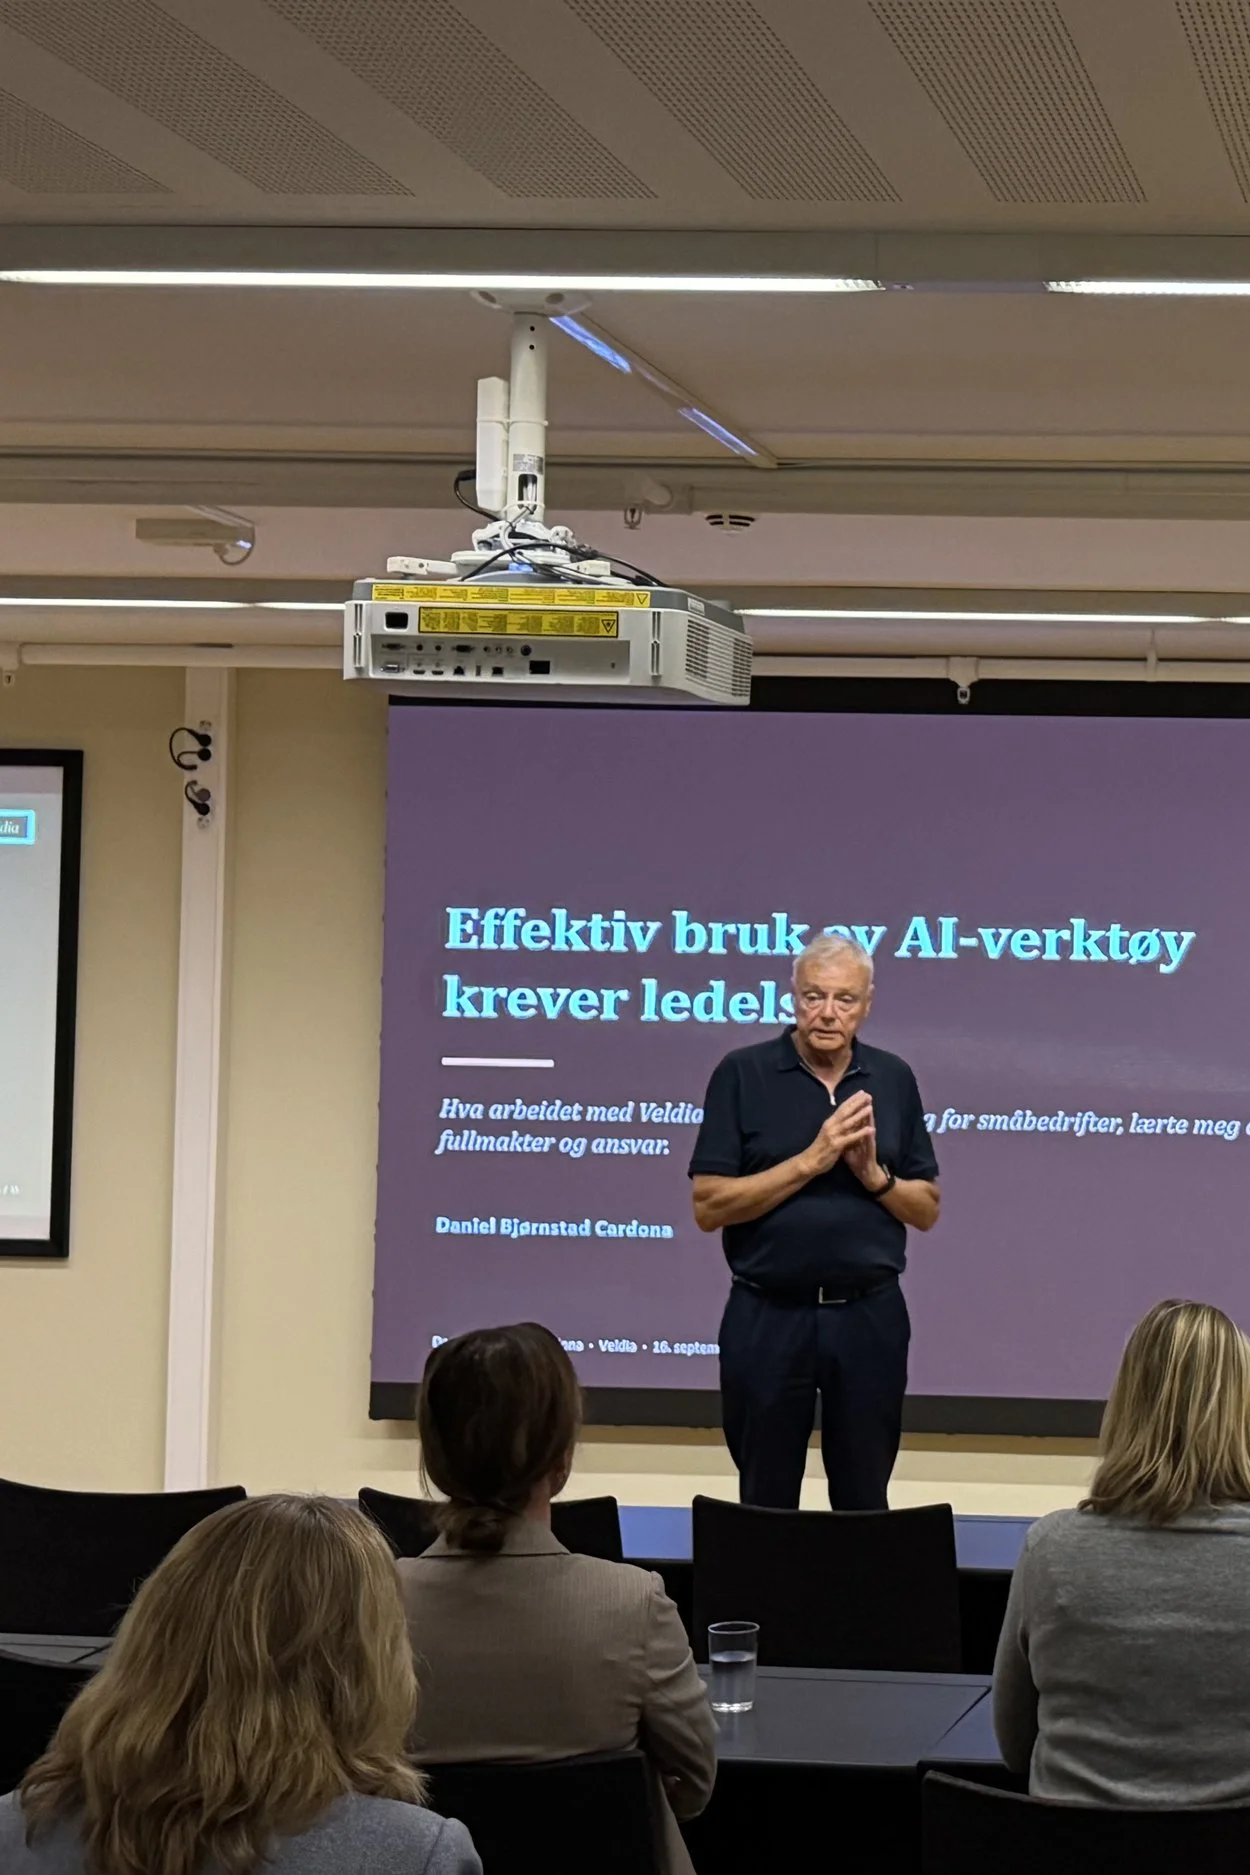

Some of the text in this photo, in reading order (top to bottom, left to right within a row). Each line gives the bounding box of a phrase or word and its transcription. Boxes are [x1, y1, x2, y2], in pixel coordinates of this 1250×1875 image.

[445, 908, 662, 952] Effektiv
[672, 911, 807, 955] bruk
[895, 916, 1196, 974] AI-verktøy
[443, 975, 629, 1020] krever
[440, 1099, 484, 1119] Hva
[489, 1099, 583, 1121] arbeidet
[586, 1101, 634, 1122] med
[937, 1108, 975, 1133] for
[977, 1110, 1123, 1136] småbedrifter,
[1129, 1113, 1188, 1134] lærte
[1193, 1120, 1241, 1140] meg
[435, 1130, 669, 1157] fullmakter og ansvar.
[436, 1217, 673, 1238] Daniel Bjørnstad Cardona
